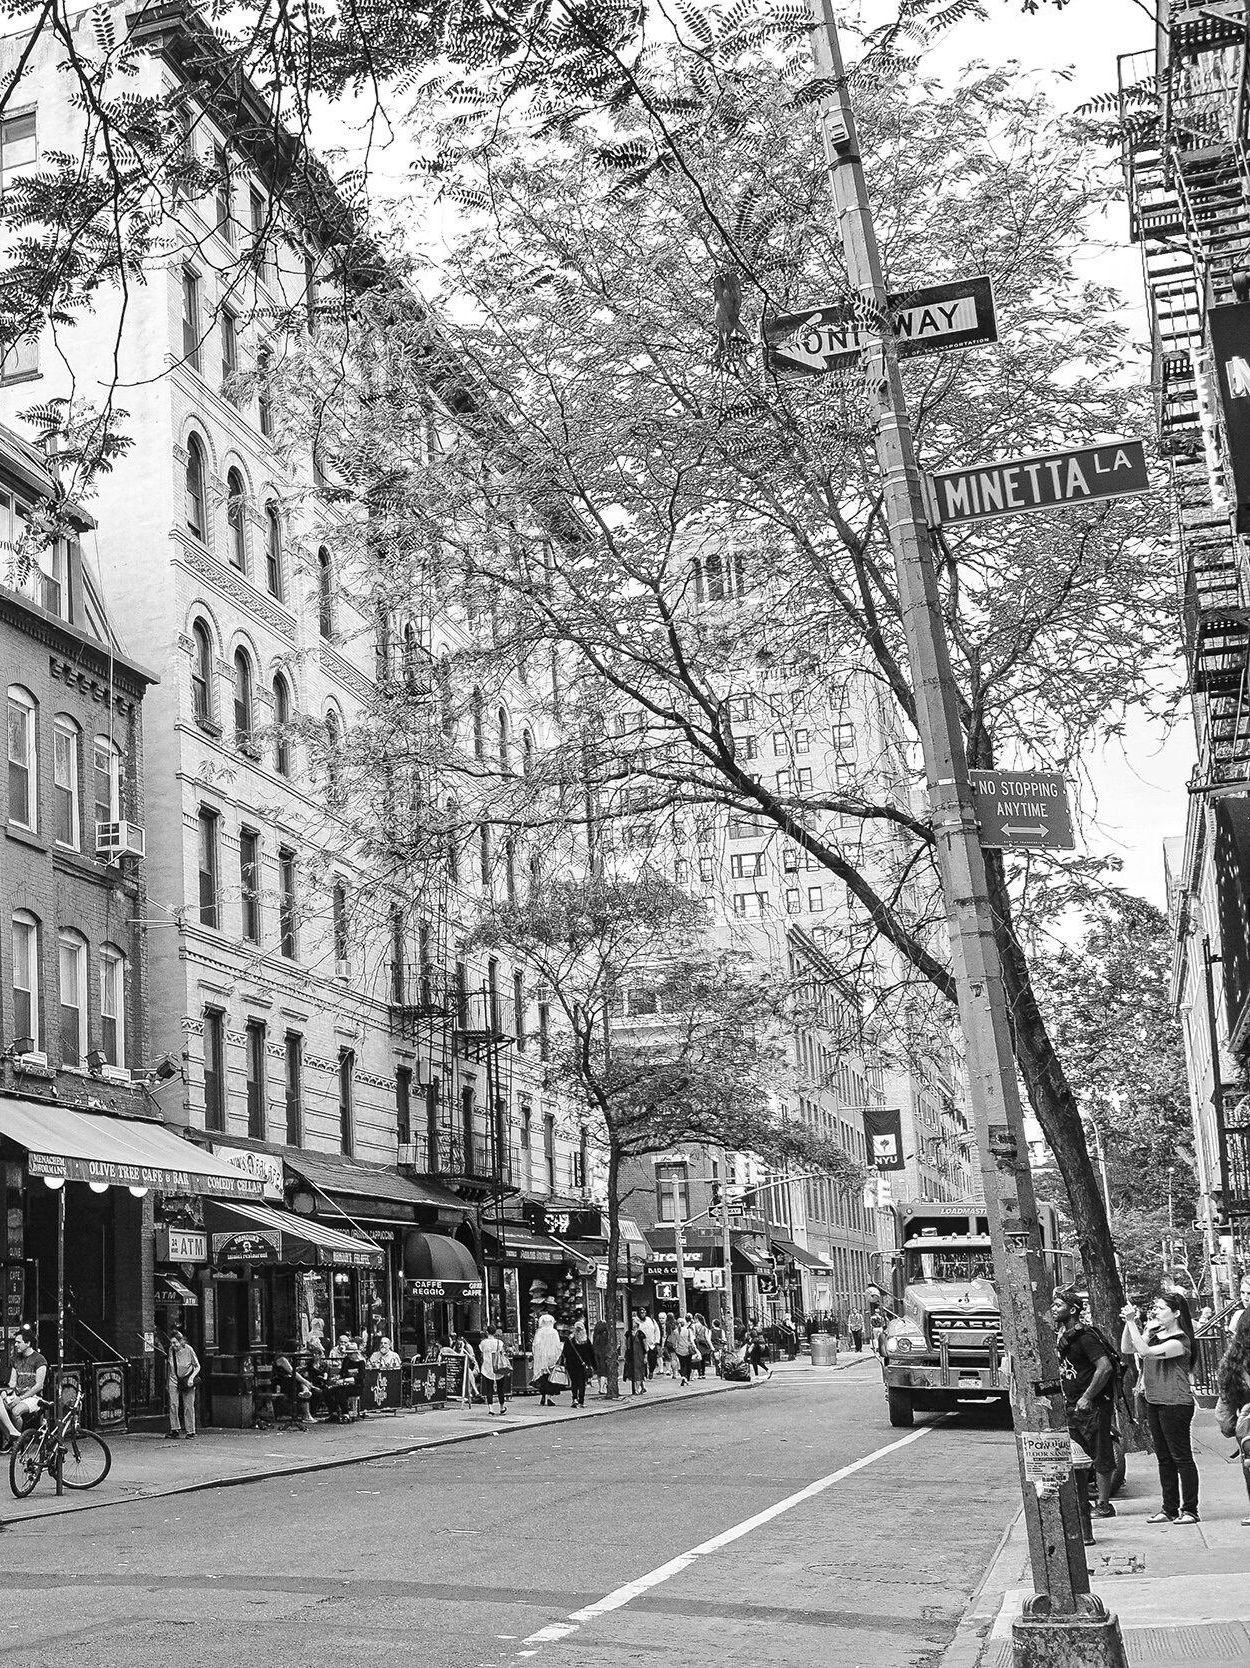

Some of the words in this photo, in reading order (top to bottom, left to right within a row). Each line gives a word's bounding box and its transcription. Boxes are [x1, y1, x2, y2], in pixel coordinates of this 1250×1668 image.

[803, 328, 861, 355] ON
[898, 303, 959, 337] WAY
[944, 457, 1091, 518] MINETTA
[1093, 449, 1132, 474] LA
[978, 780, 996, 795] NO
[1001, 781, 1058, 797] STOPPING
[997, 801, 1049, 817] ANYTIME
[874, 1155, 898, 1165] NYU
[89, 1161, 116, 1177] OLIVE
[117, 1165, 140, 1180] TREE
[141, 1168, 163, 1183] CAFE
[173, 1171, 190, 1185] BAR
[207, 1176, 235, 1191] COMEDY
[940, 1207, 988, 1215] LOADMAST
[180, 1237, 203, 1256] ATM
[412, 1288, 445, 1296] REGGIO
[414, 1281, 443, 1289] CAFFE
[154, 1291, 177, 1300] ATM
[934, 1320, 1001, 1328] MACK
